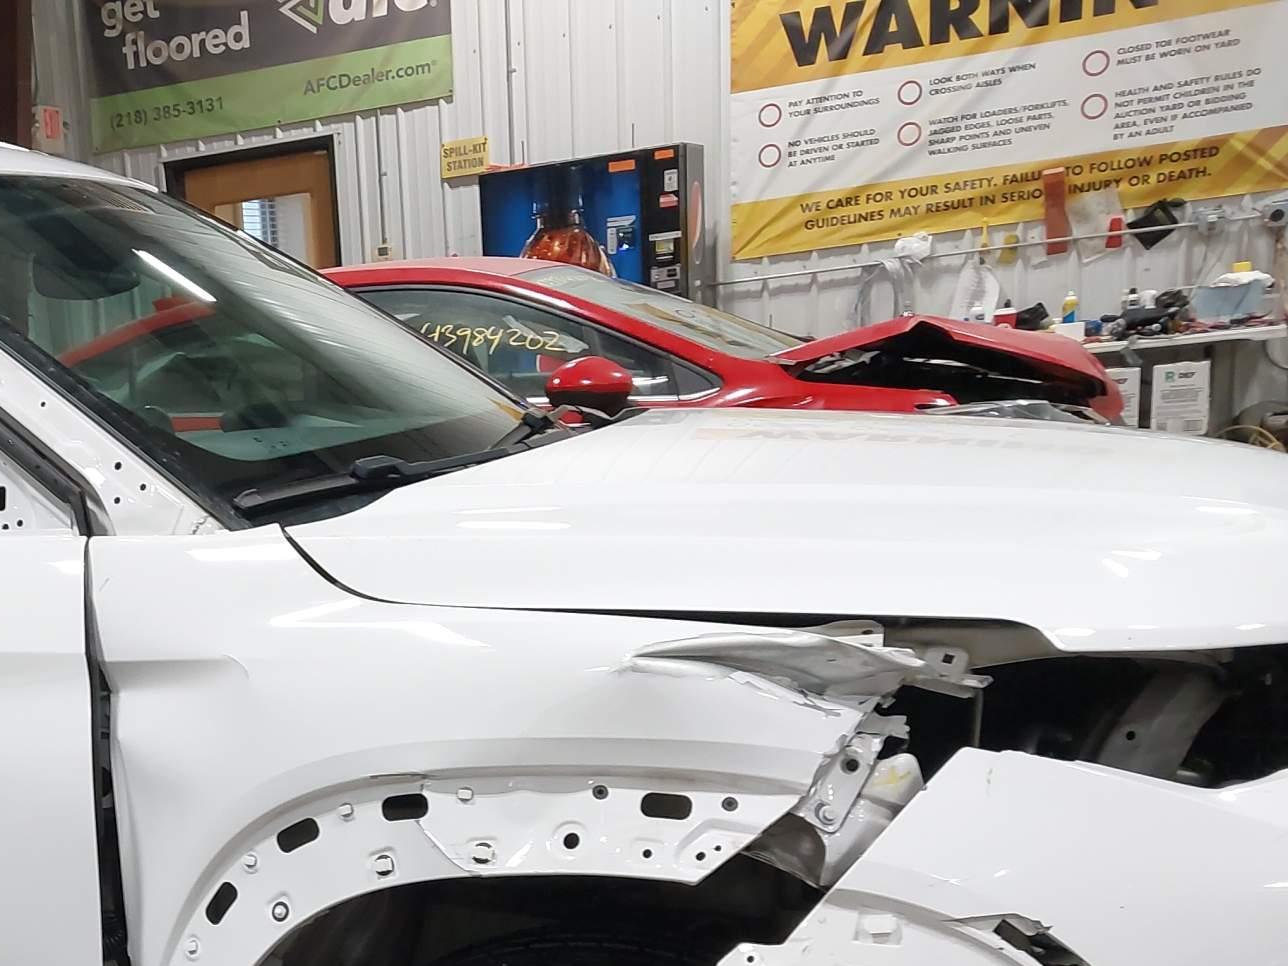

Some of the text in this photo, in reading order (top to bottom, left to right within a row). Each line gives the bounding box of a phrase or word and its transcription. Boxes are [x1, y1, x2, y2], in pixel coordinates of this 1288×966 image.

[101, 0, 160, 37] get
[122, 10, 251, 70] floored
[779, 0, 1159, 67] WARN
[1116, 29, 1231, 55] CLOSED TOE FOOTWEAR
[1116, 38, 1240, 66] MUST BE WORN ON YARD
[929, 63, 1037, 86] LOOK BOTH WAYS WHEN
[1114, 67, 1262, 98] HEALTH AND SAFETY RULES DO
[929, 78, 1003, 96] CROSSING AISLES
[1114, 79, 1255, 108] NOT PERMIT CHILDREN IN THE
[788, 90, 863, 108] PAY ATTENTION TO
[788, 98, 880, 118] YOUR SURROUNDINGS
[1113, 92, 1247, 120] AUCTION YARD OR BIDDING
[110, 96, 224, 131] (218) 385-3131
[928, 115, 958, 126] WATCH
[961, 112, 977, 122] FOR
[1143, 116, 1168, 126] EVEN
[1170, 113, 1178, 121] IF
[1181, 102, 1253, 120] ACCOMPANIED
[928, 125, 961, 136] JAGGED
[996, 116, 1024, 127] LOOSE
[928, 123, 1050, 146] SHARP POINTS AND UNEVEN
[1113, 125, 1175, 141] BY AN ADULT
[788, 128, 876, 148] NO VEHICLES SHOULD
[788, 138, 880, 158] BE DRIVEN OR STARTED
[928, 138, 1013, 156] WALKING SURFACES
[443, 142, 487, 159] SPILL-KIT
[788, 155, 835, 168] AT ANYTIME
[446, 157, 484, 172] STATION
[800, 146, 1220, 214] WE CARE FOR YOUR SAFETY. FAILU TO FOLLOW POSTED
[804, 166, 1212, 231] GUIDELINES MAY RESULT IN SERIO INJURY OR DEATH.
